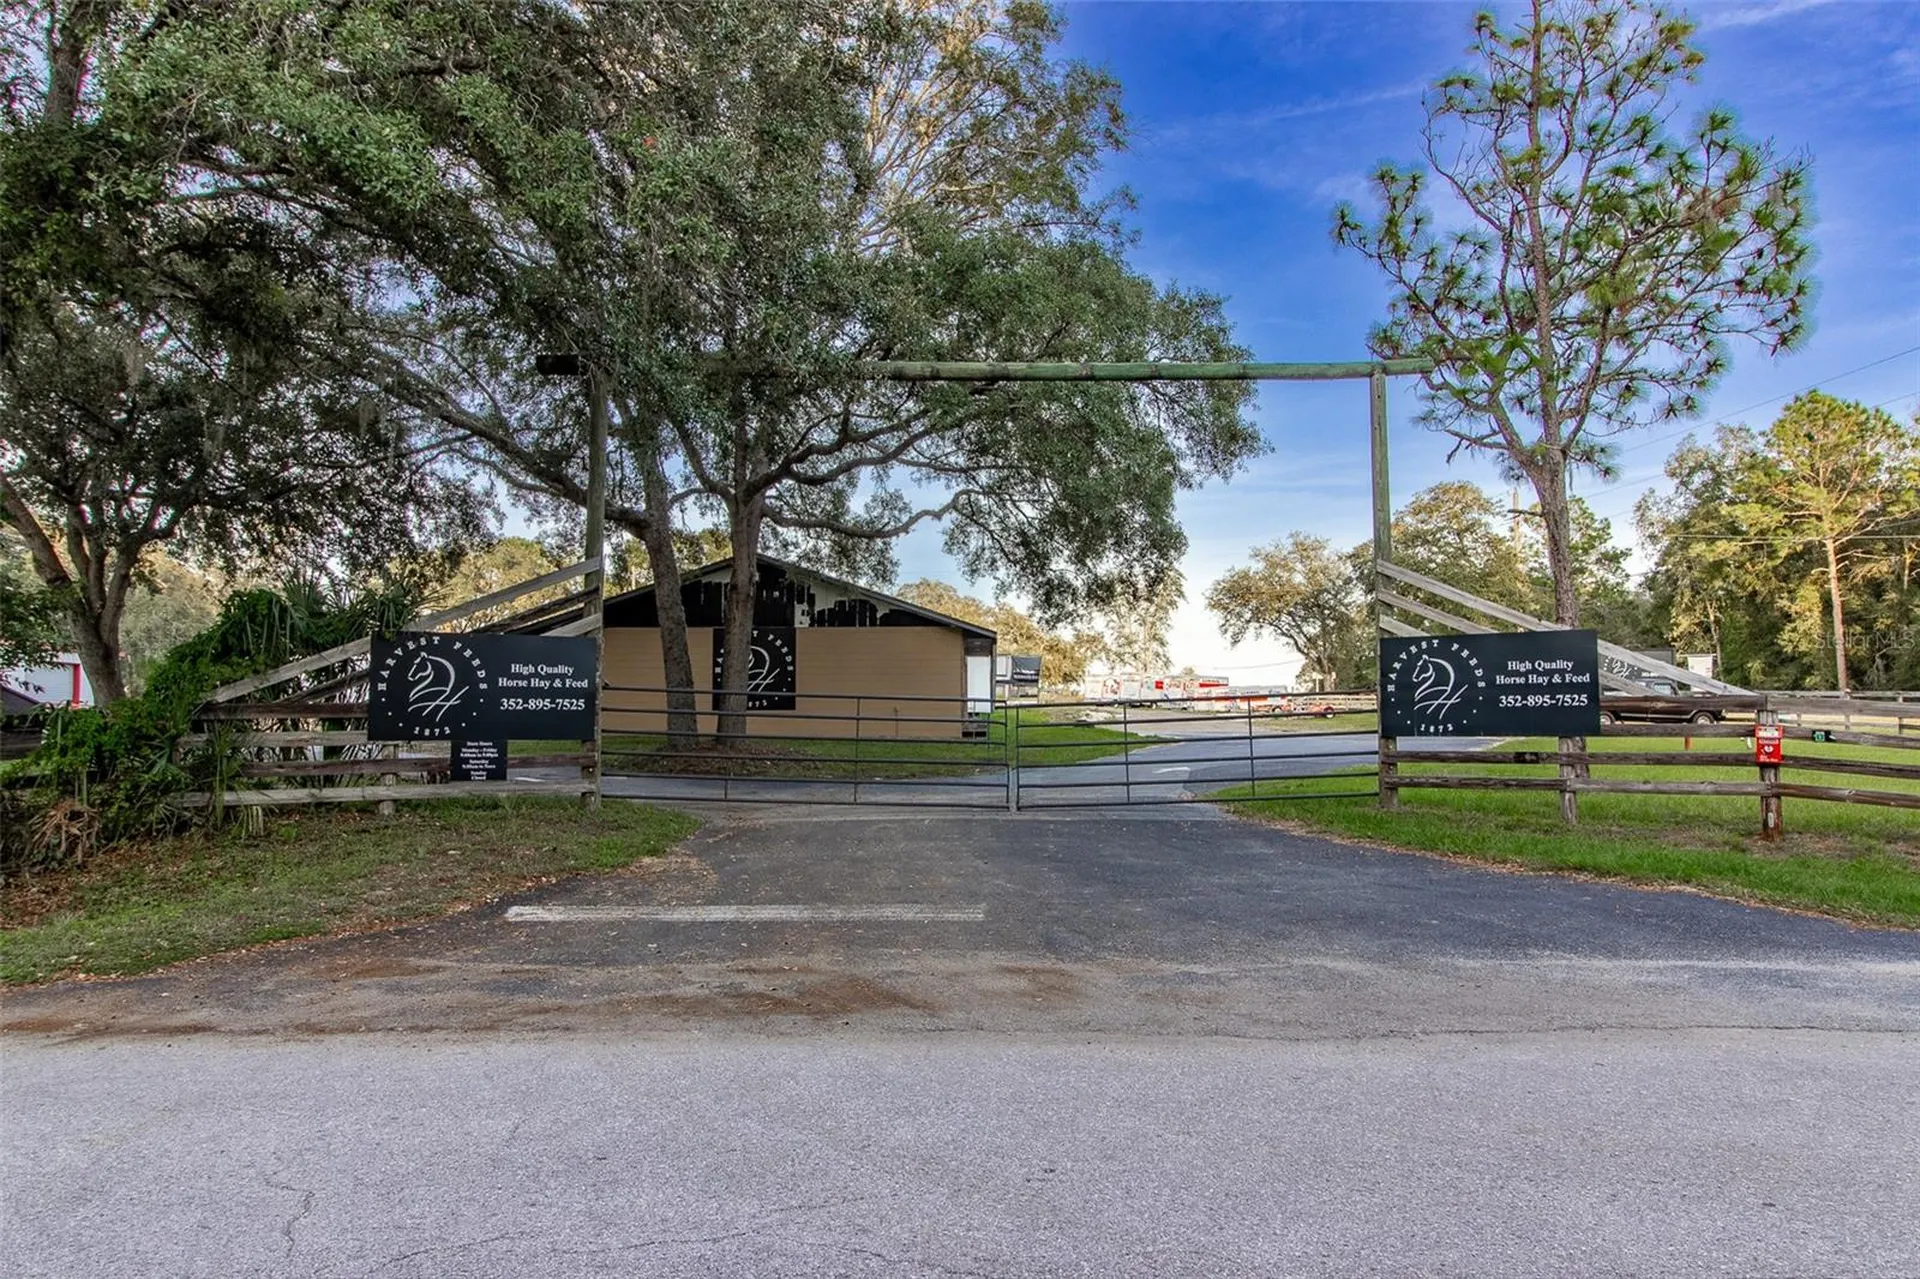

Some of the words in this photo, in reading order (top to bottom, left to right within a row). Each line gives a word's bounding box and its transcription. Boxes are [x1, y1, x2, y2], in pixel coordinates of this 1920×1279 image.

[377, 635, 441, 691] HARVEST
[453, 641, 488, 690] FEEDS
[511, 663, 536, 675] High
[537, 663, 575, 676] Quality
[1387, 639, 1440, 692] HARVEST
[1451, 642, 1486, 688] FEEDS
[1507, 660, 1532, 672] High
[1534, 659, 1574, 671] Quality
[498, 678, 528, 688] Horse
[530, 678, 551, 690] Hay
[552, 678, 563, 688] &
[565, 678, 589, 688] Feed
[1495, 674, 1526, 684] Horse
[1528, 674, 1550, 686] Hay
[1552, 674, 1562, 683] &
[1565, 673, 1590, 683] Feed
[500, 698, 586, 711] 352-895-7525
[1498, 694, 1588, 707] 352-895-7525
[413, 726, 451, 737] 1872
[1420, 723, 1454, 733] 1872
